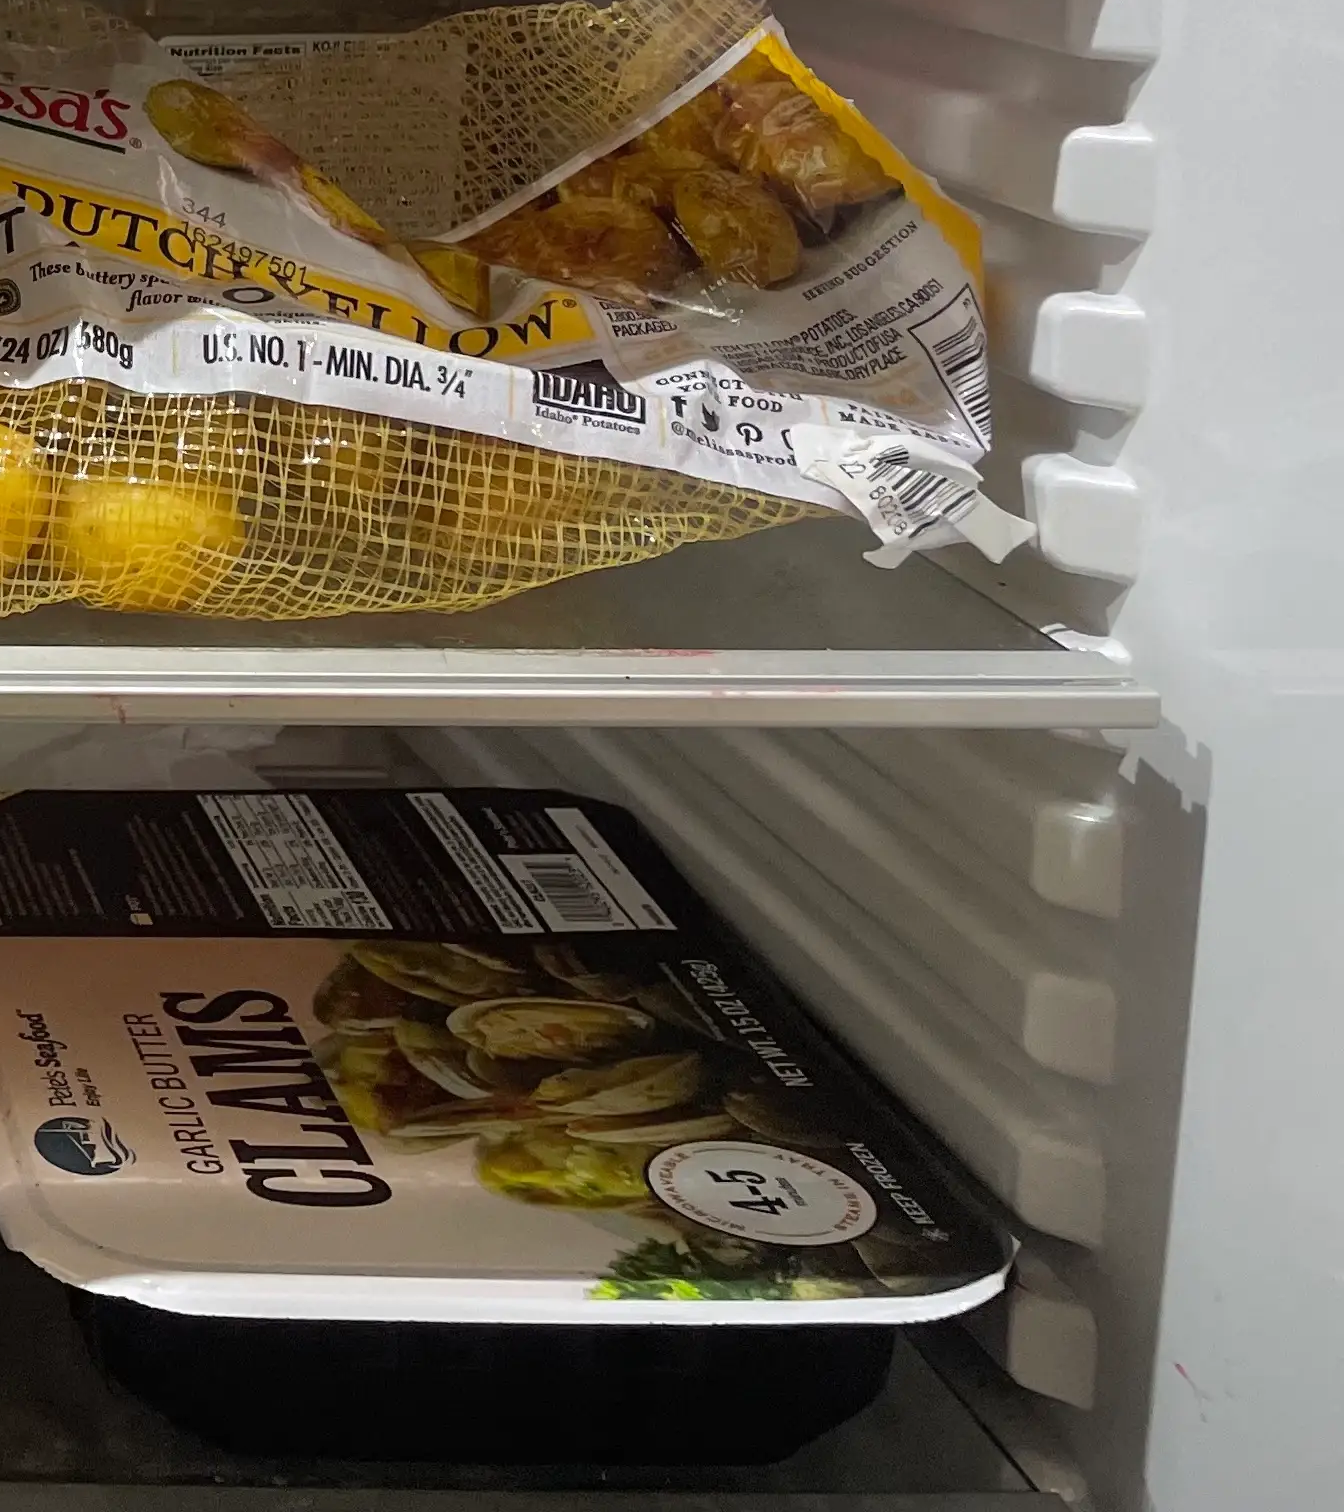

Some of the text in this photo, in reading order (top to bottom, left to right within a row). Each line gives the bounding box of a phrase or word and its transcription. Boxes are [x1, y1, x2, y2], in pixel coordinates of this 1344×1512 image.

[169, 45, 302, 58] Nutrition Facts
[182, 196, 228, 228] 344
[29, 261, 136, 288] These buttery
[126, 288, 183, 312] flavor
[36, 325, 69, 358] OZ)
[202, 333, 431, 394] U.S. NO. DIA.
[582, 415, 641, 436] Potatoes
[714, 999, 750, 1016] OZ
[730, 1017, 767, 1036] 15
[747, 1035, 789, 1058] WT.
[765, 1061, 814, 1088] NET
[123, 1011, 224, 1175] GARLIC BUTTER
[159, 989, 393, 1208] CLAMS
[704, 1168, 789, 1217] 4-5
[846, 1141, 935, 1225] KEEP FROZEN
